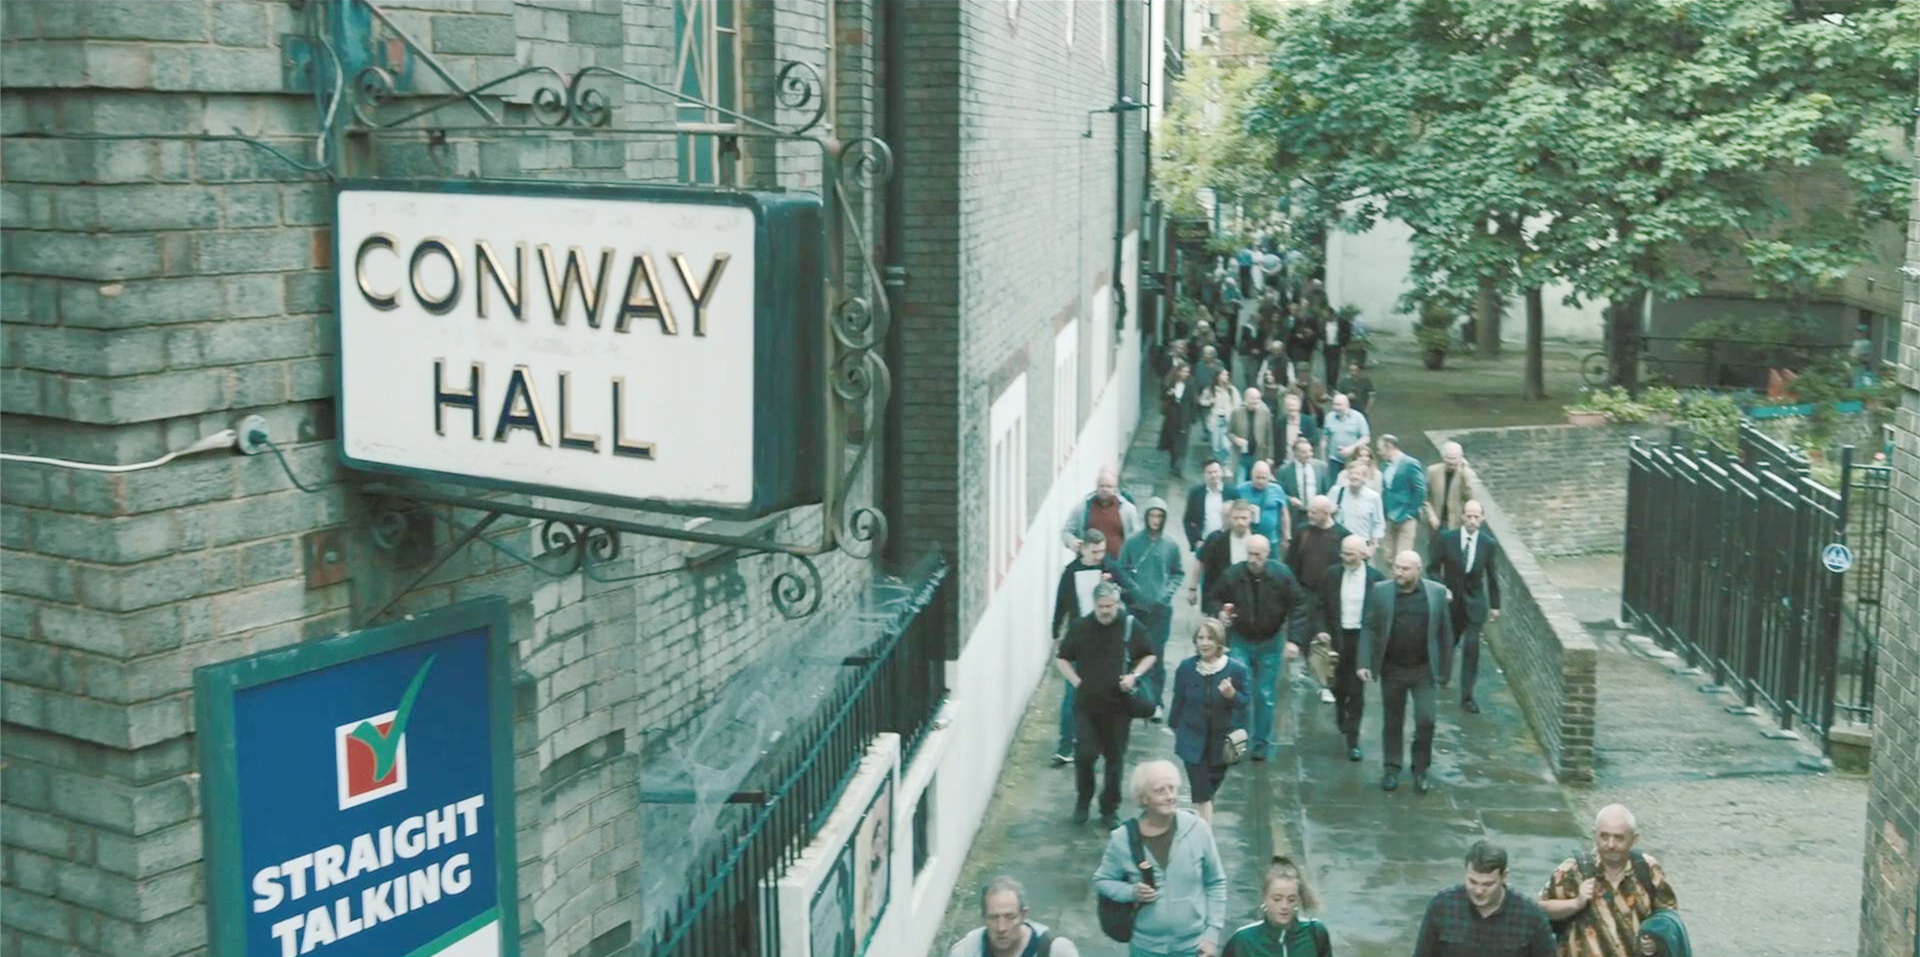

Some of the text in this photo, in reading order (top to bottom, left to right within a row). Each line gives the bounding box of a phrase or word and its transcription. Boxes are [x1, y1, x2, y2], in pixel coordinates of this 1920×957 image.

[354, 234, 730, 336] CONWAY
[433, 359, 655, 459] HALL
[252, 794, 485, 913] STRAIGHT
[272, 854, 472, 957] TALKING
